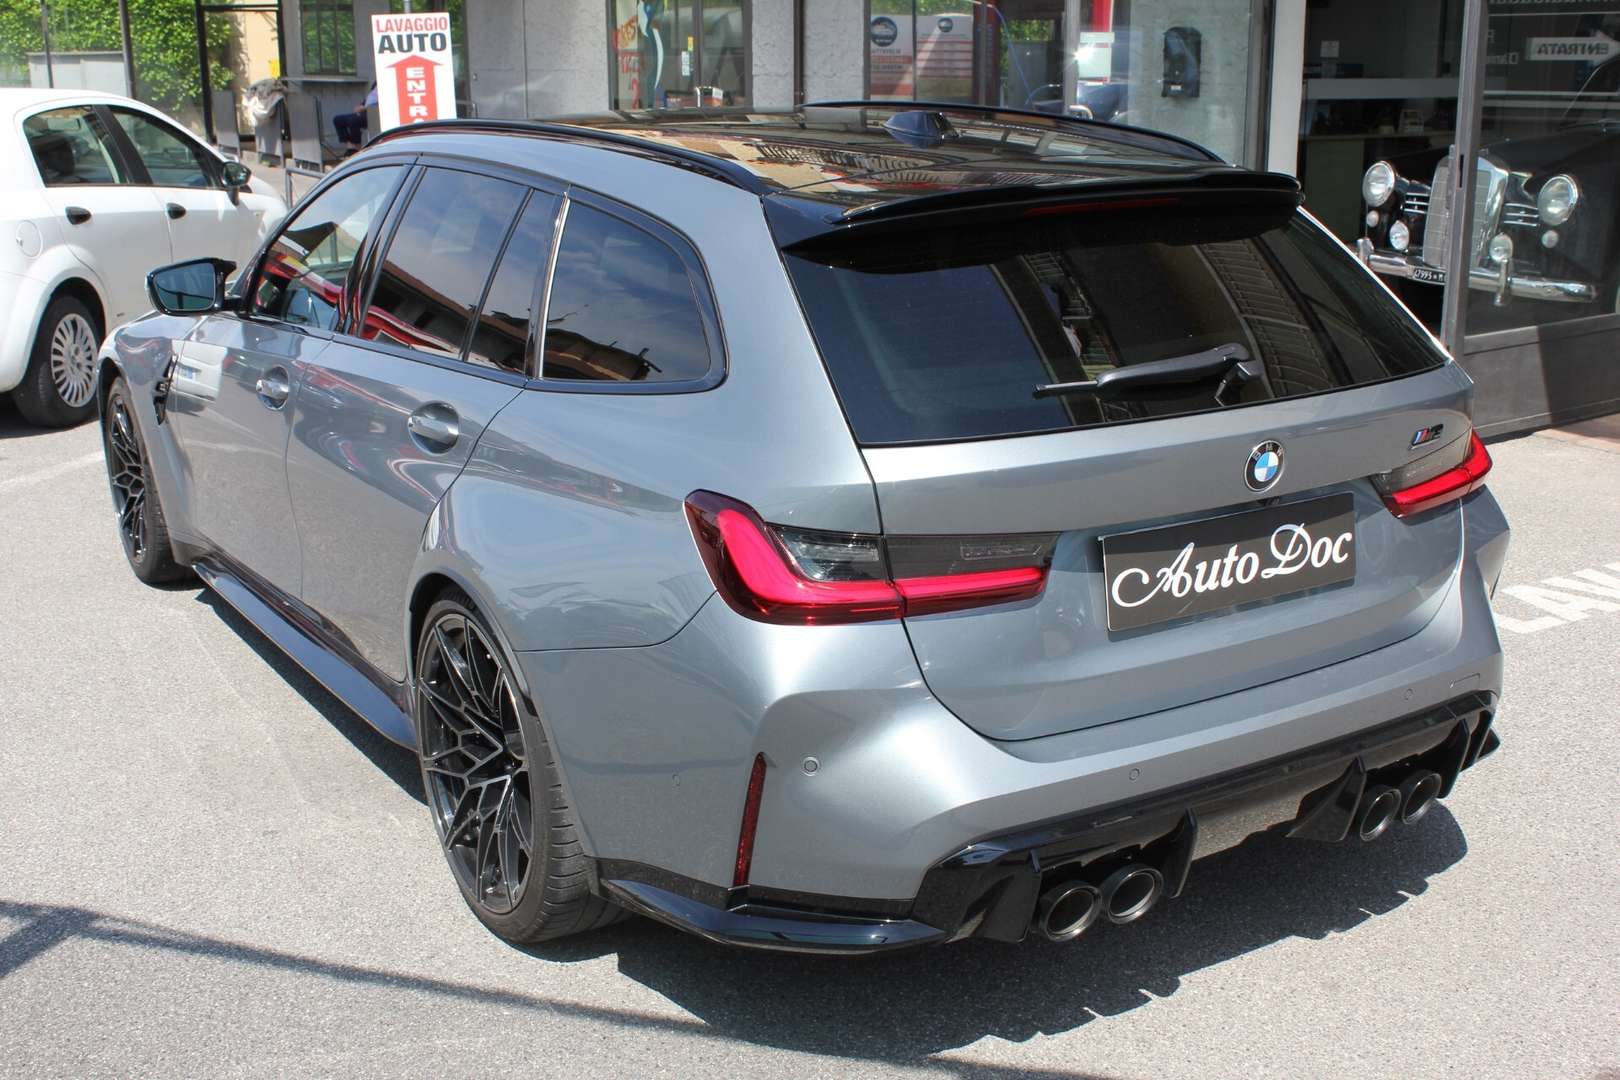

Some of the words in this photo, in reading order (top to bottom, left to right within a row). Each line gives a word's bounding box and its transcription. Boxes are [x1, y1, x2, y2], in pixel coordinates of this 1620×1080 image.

[376, 17, 448, 33] LAVAGGIO
[378, 32, 447, 54] AUTO
[1111, 542, 1260, 608] Auto
[1260, 523, 1352, 579] Doc
